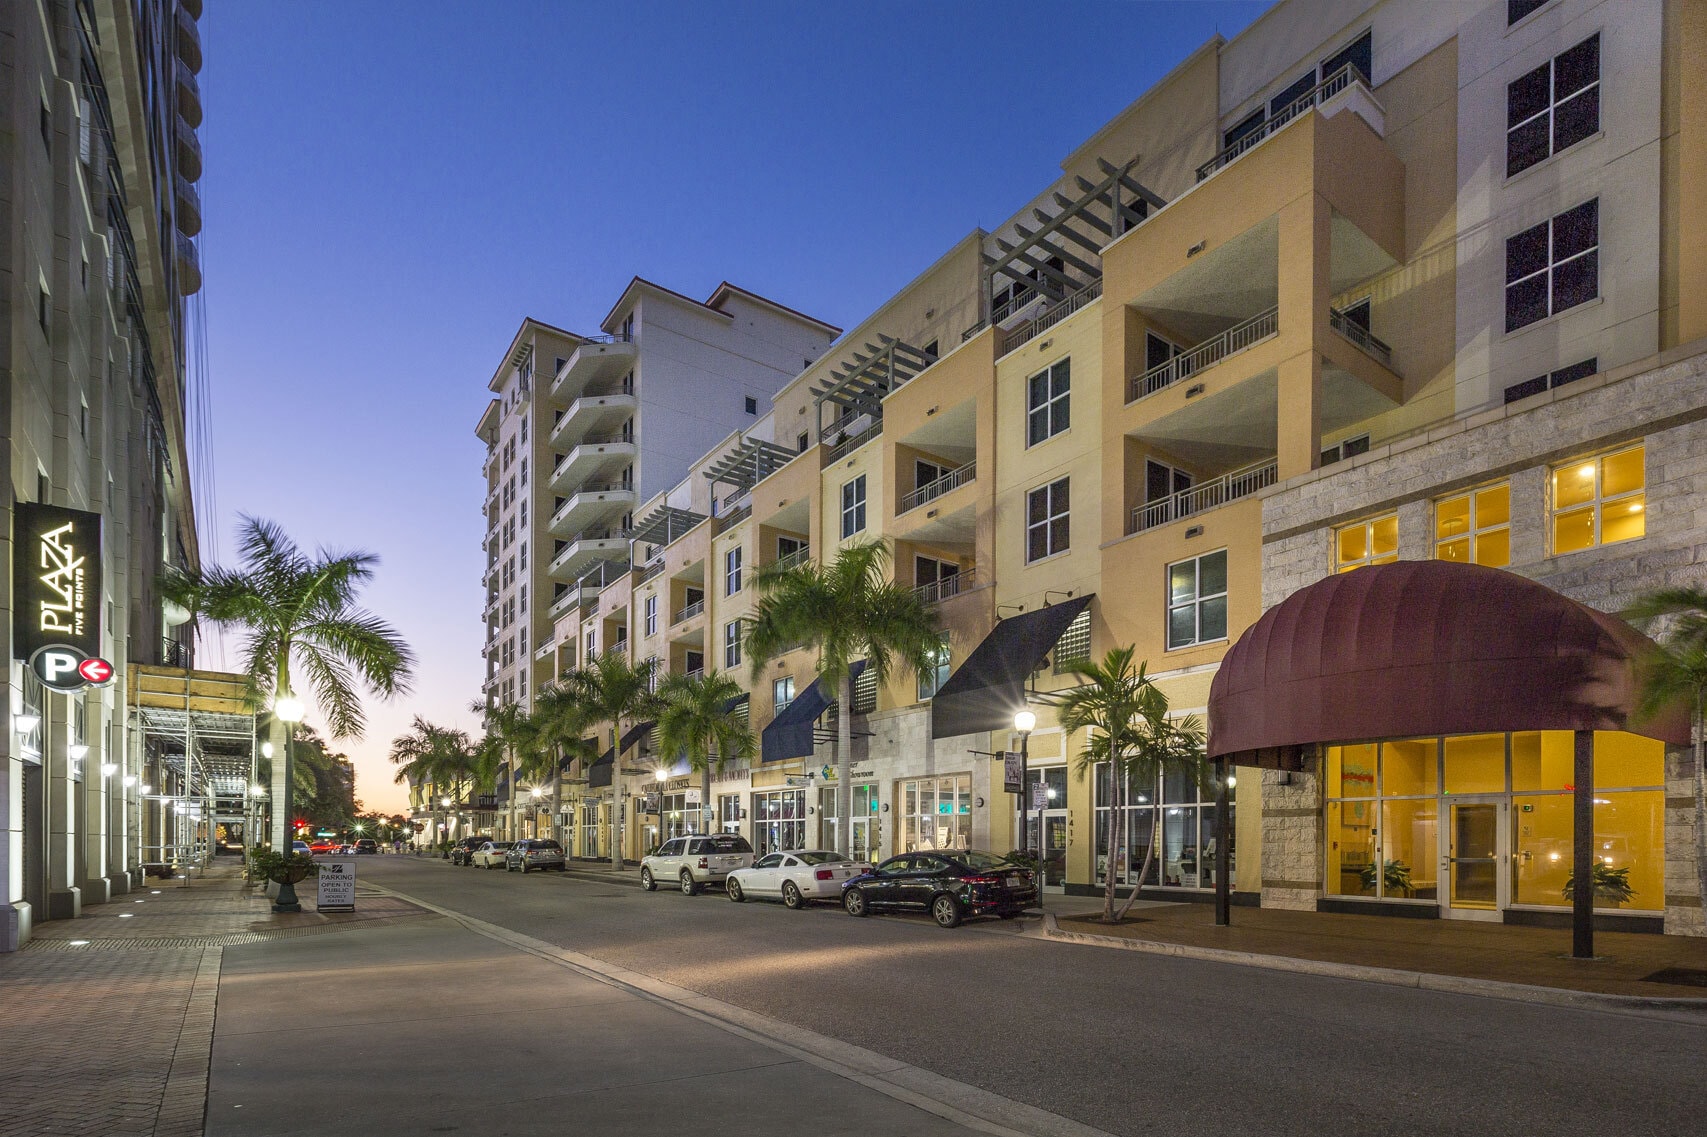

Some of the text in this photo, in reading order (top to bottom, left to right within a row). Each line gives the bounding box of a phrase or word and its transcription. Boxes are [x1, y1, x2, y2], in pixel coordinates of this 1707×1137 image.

[40, 521, 84, 635] PLAZA
[75, 568, 84, 636] FIVE POINTS
[45, 652, 77, 682] P
